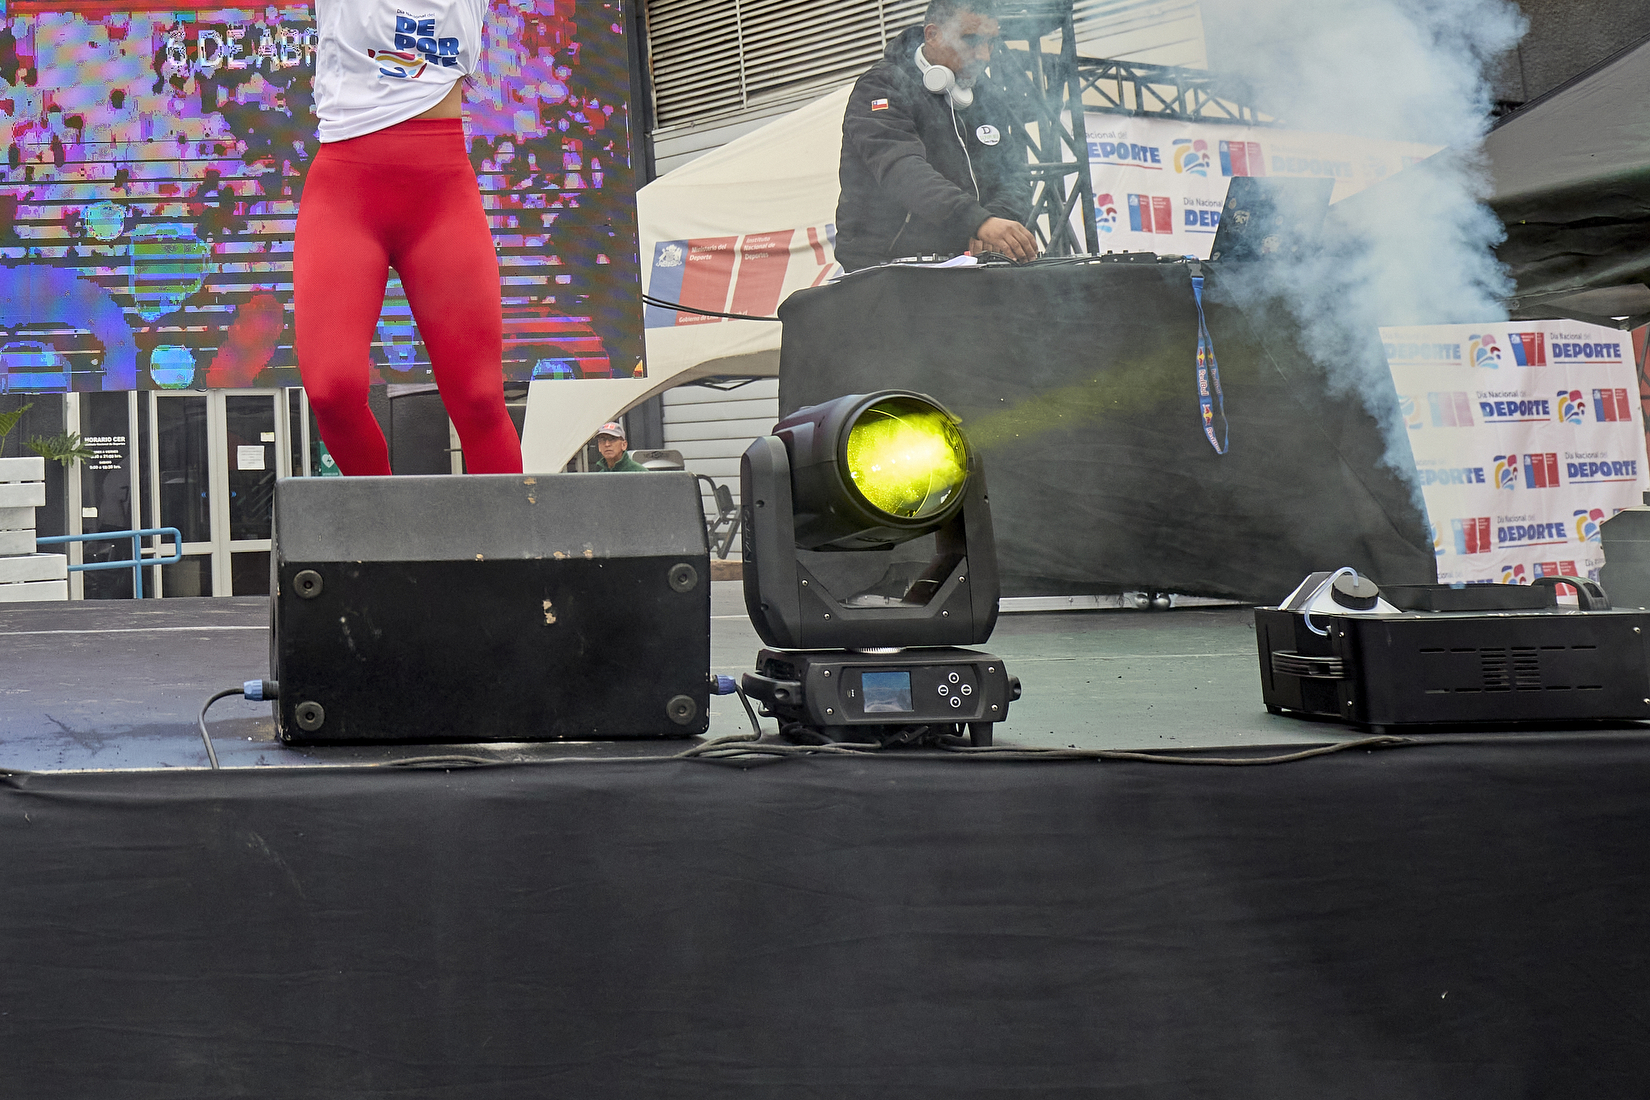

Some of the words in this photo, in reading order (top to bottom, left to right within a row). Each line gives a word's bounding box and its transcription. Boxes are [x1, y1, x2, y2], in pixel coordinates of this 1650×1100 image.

[395, 15, 435, 36] DE
[198, 25, 248, 71] DE
[394, 33, 460, 55] POR
[1087, 142, 1161, 164] EPORTE
[691, 244, 717, 253] Ministerio
[744, 243, 767, 251] Nacional
[744, 252, 769, 260] Deportes
[689, 254, 712, 262] Deporte
[1552, 343, 1622, 358] DEPORTE
[1479, 400, 1550, 417] DEPORTE
[1417, 467, 1486, 485] EPORTE
[1567, 460, 1637, 478] DEPORTE
[1498, 522, 1567, 543] DEPORTE
